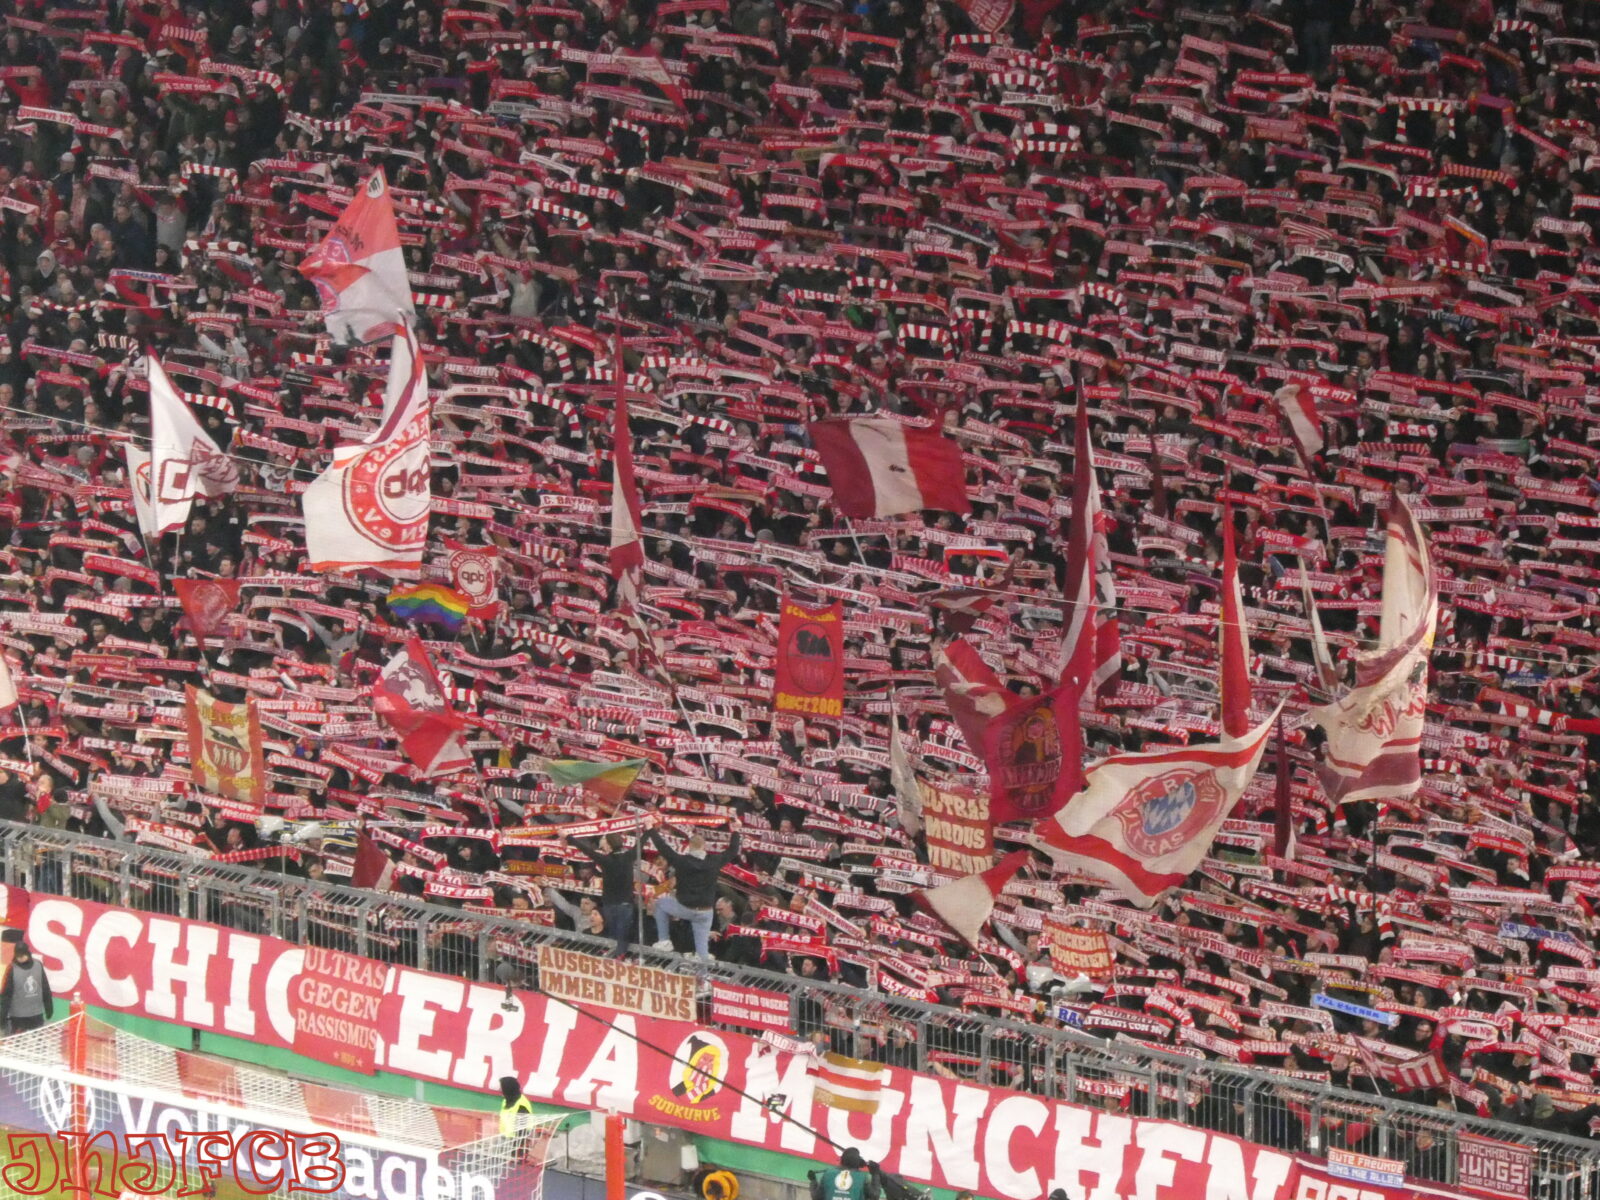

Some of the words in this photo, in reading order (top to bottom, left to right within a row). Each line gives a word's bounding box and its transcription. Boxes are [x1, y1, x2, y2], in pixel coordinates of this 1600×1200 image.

[305, 948, 386, 990] ULTRAS
[539, 946, 694, 998] AUSGESPERRTE
[28, 899, 640, 1114] SCHICERIA
[298, 978, 382, 1022] GEGEN
[540, 971, 607, 1004] IMMER
[612, 983, 644, 1007] BEI
[652, 993, 692, 1020] UNS
[296, 1008, 378, 1051] RASSISMUS
[1459, 1153, 1529, 1186] JUNGS!
